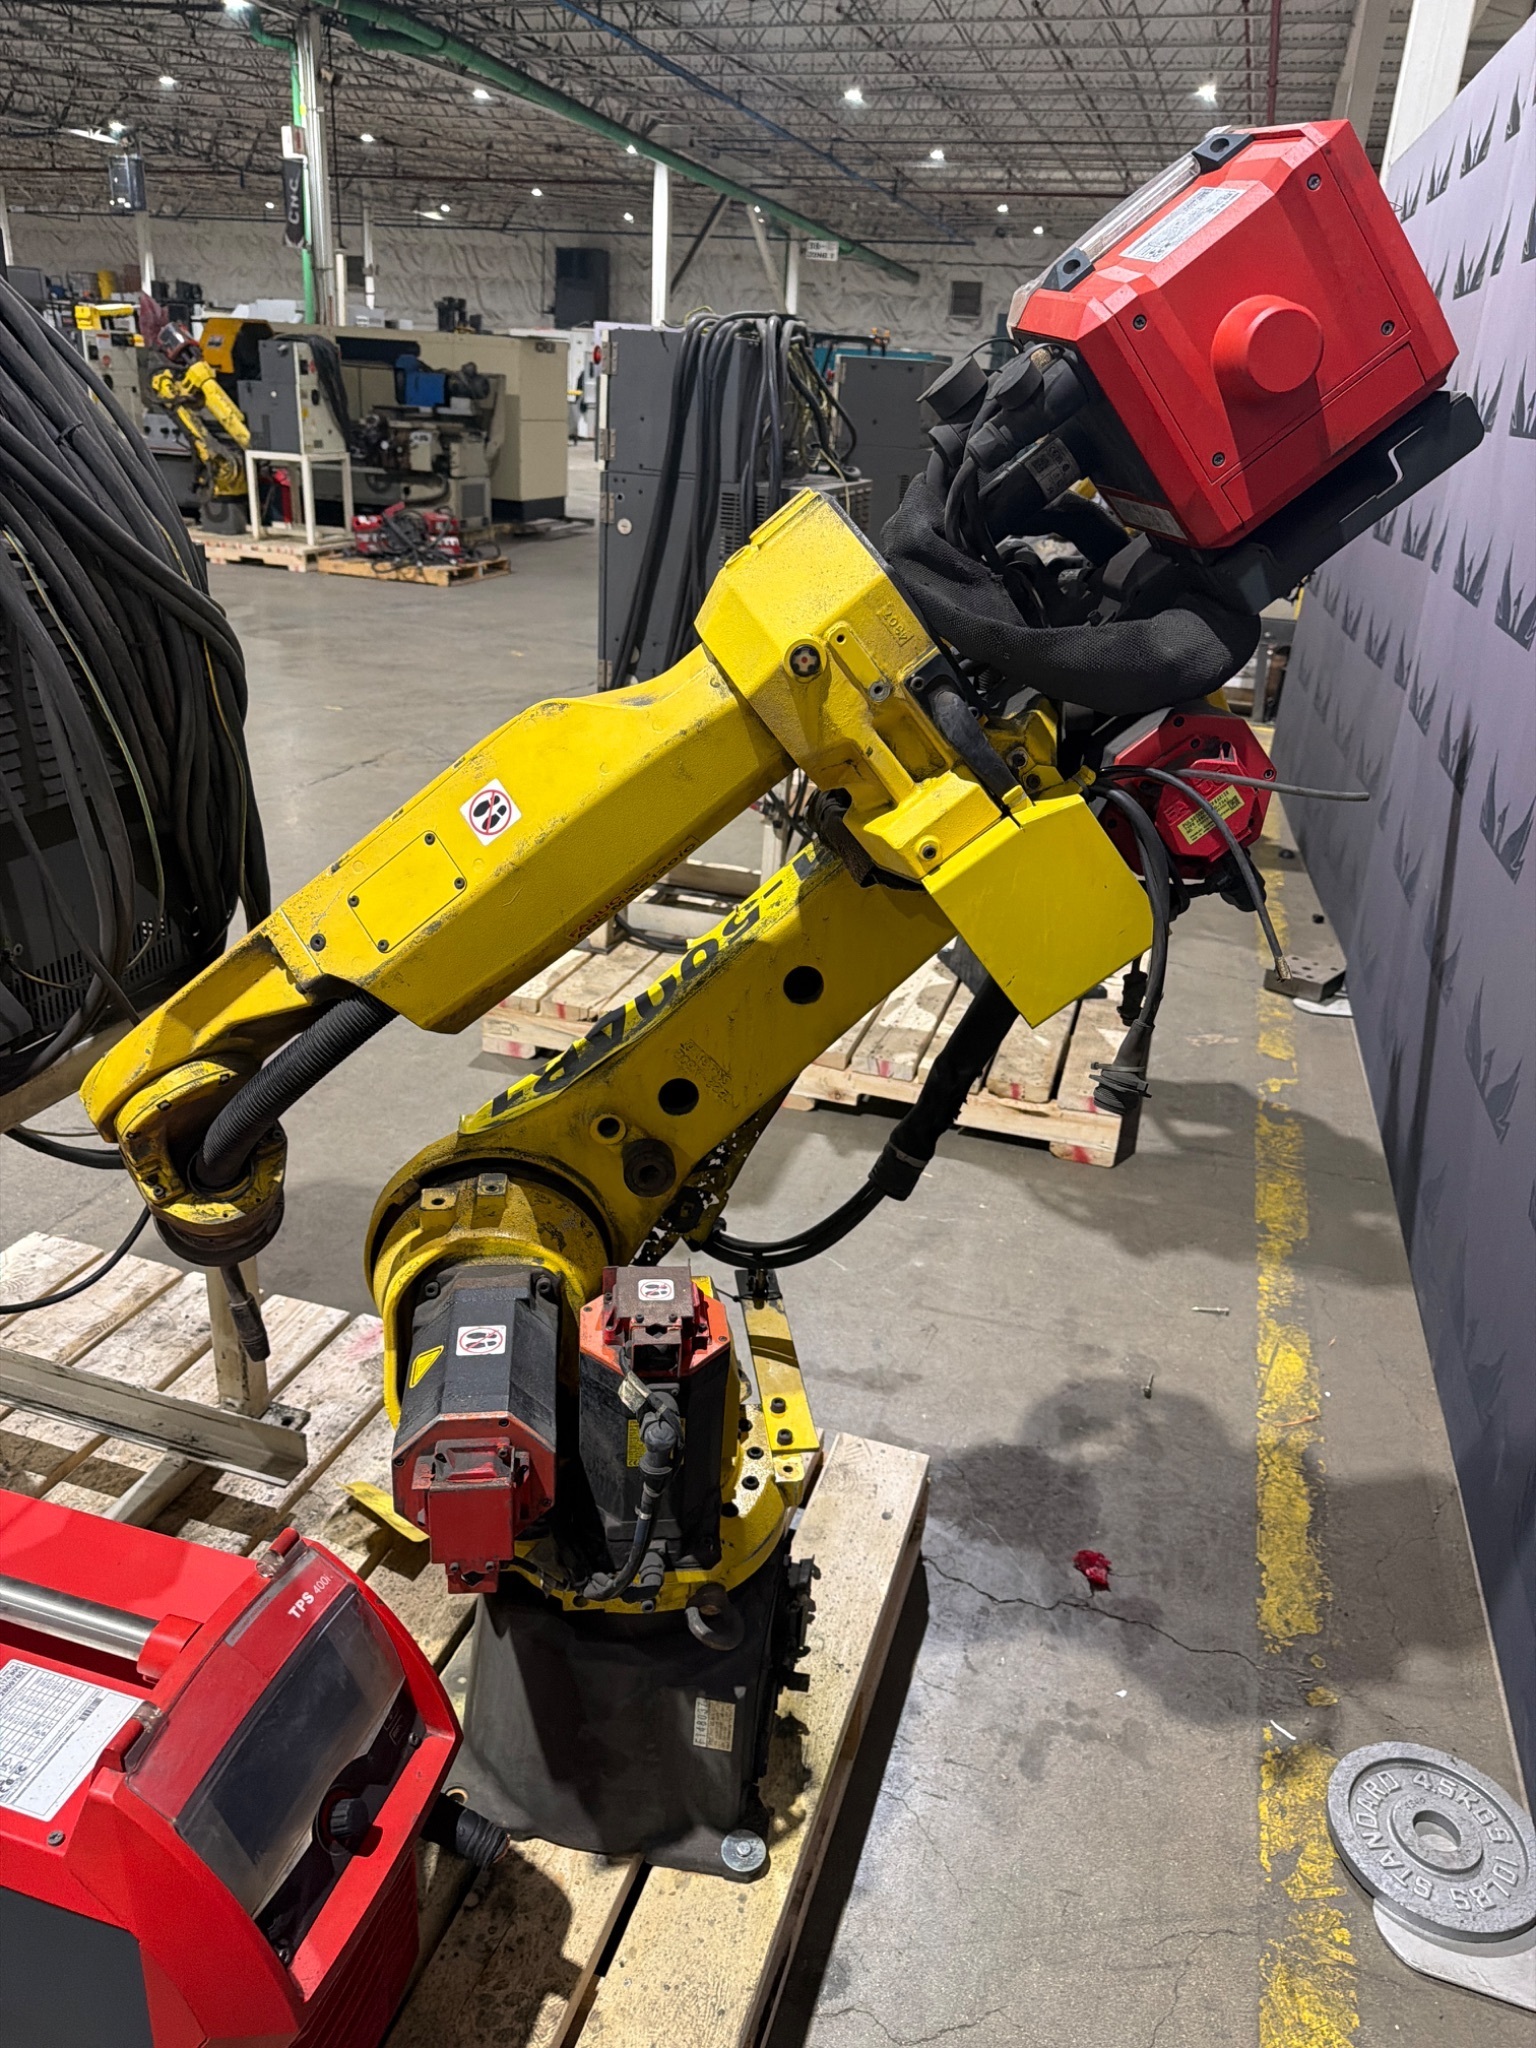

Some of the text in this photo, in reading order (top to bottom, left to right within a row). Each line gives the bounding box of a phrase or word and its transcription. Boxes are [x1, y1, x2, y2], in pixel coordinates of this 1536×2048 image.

[288, 177, 300, 225] CNC
[569, 895, 622, 938] FANUC
[611, 881, 648, 911] Mate
[287, 1591, 315, 1619] TPS
[312, 1574, 332, 1594] 400i
[1355, 1772, 1433, 1900] STANDARD
[1412, 1771, 1513, 1843] 4.5KGS
